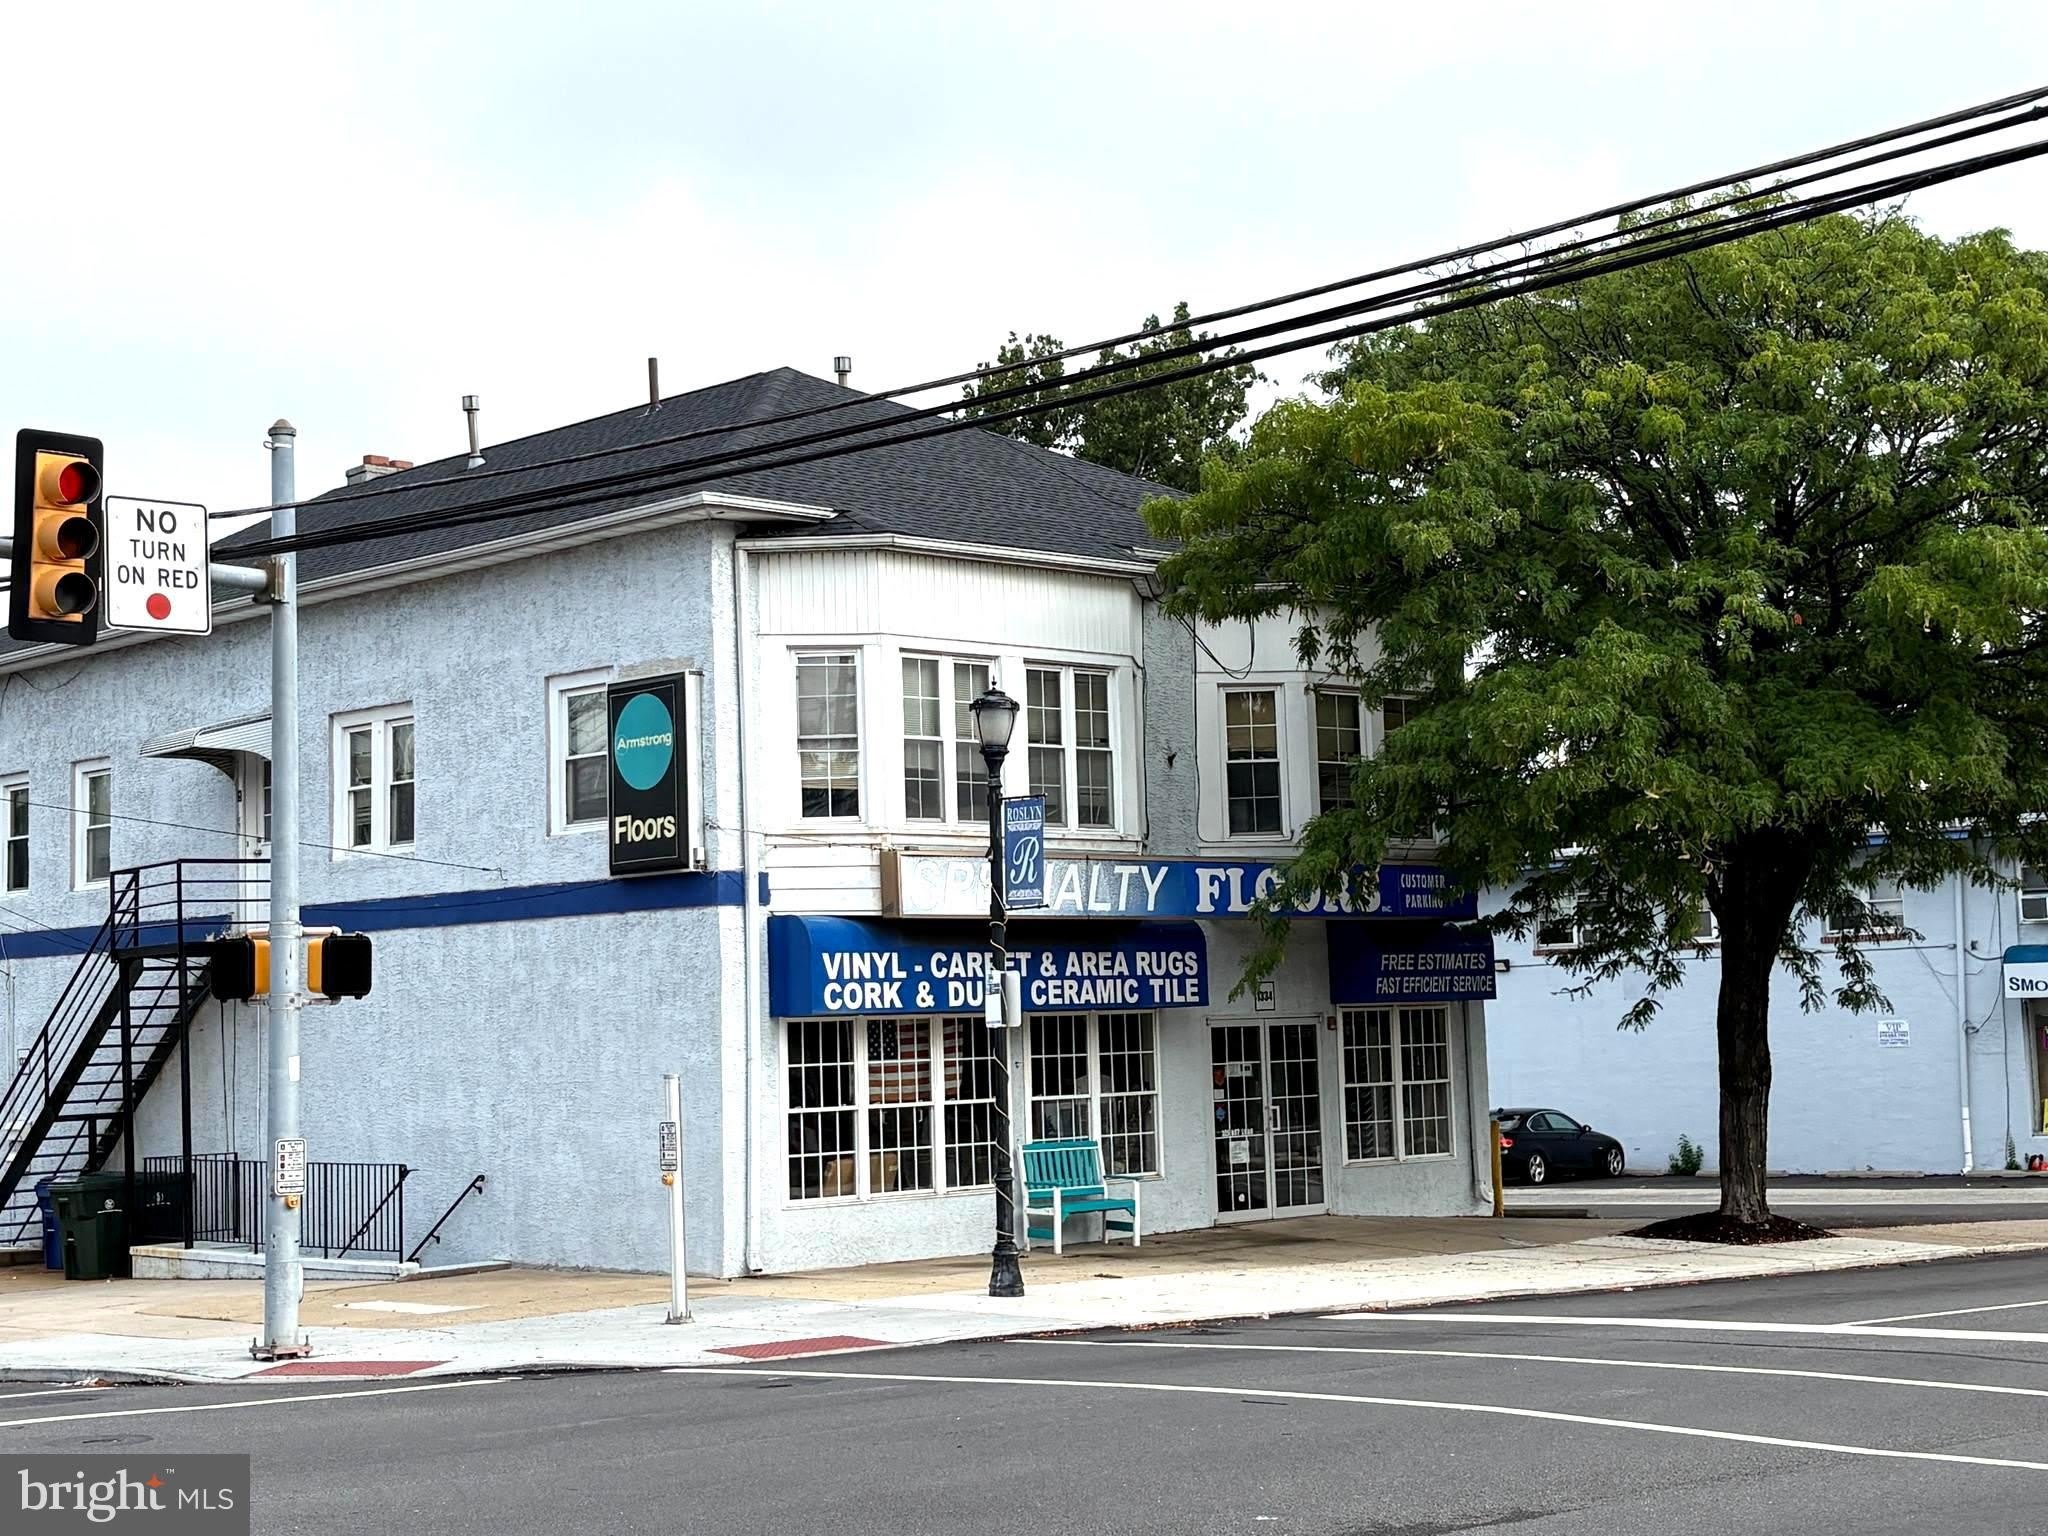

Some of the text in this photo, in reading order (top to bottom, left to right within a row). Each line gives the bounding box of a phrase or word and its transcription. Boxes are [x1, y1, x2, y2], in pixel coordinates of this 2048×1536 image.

[136, 508, 177, 534] NO
[129, 538, 186, 562] TURN
[117, 564, 199, 589] ON RED
[616, 732, 672, 750] Armstrong
[1007, 805, 1042, 821] ROSLYN
[614, 814, 676, 845] Floors
[1009, 836, 1040, 884] R
[1400, 873, 1446, 889] CUSTOMER
[1405, 894, 1444, 909] PARKING
[821, 952, 908, 980] VINYL
[1040, 951, 1058, 977] &
[1065, 951, 1130, 977] AREA
[1136, 951, 1198, 977] RUGS
[1381, 952, 1487, 971] FREE ESTIMATES
[823, 981, 903, 1010] CORK
[915, 980, 935, 1008] &
[1030, 978, 1139, 1006] CERAMIC
[1149, 978, 1200, 1004] TILE
[1375, 975, 1493, 994] FAST EFFICIENT SERVICE
